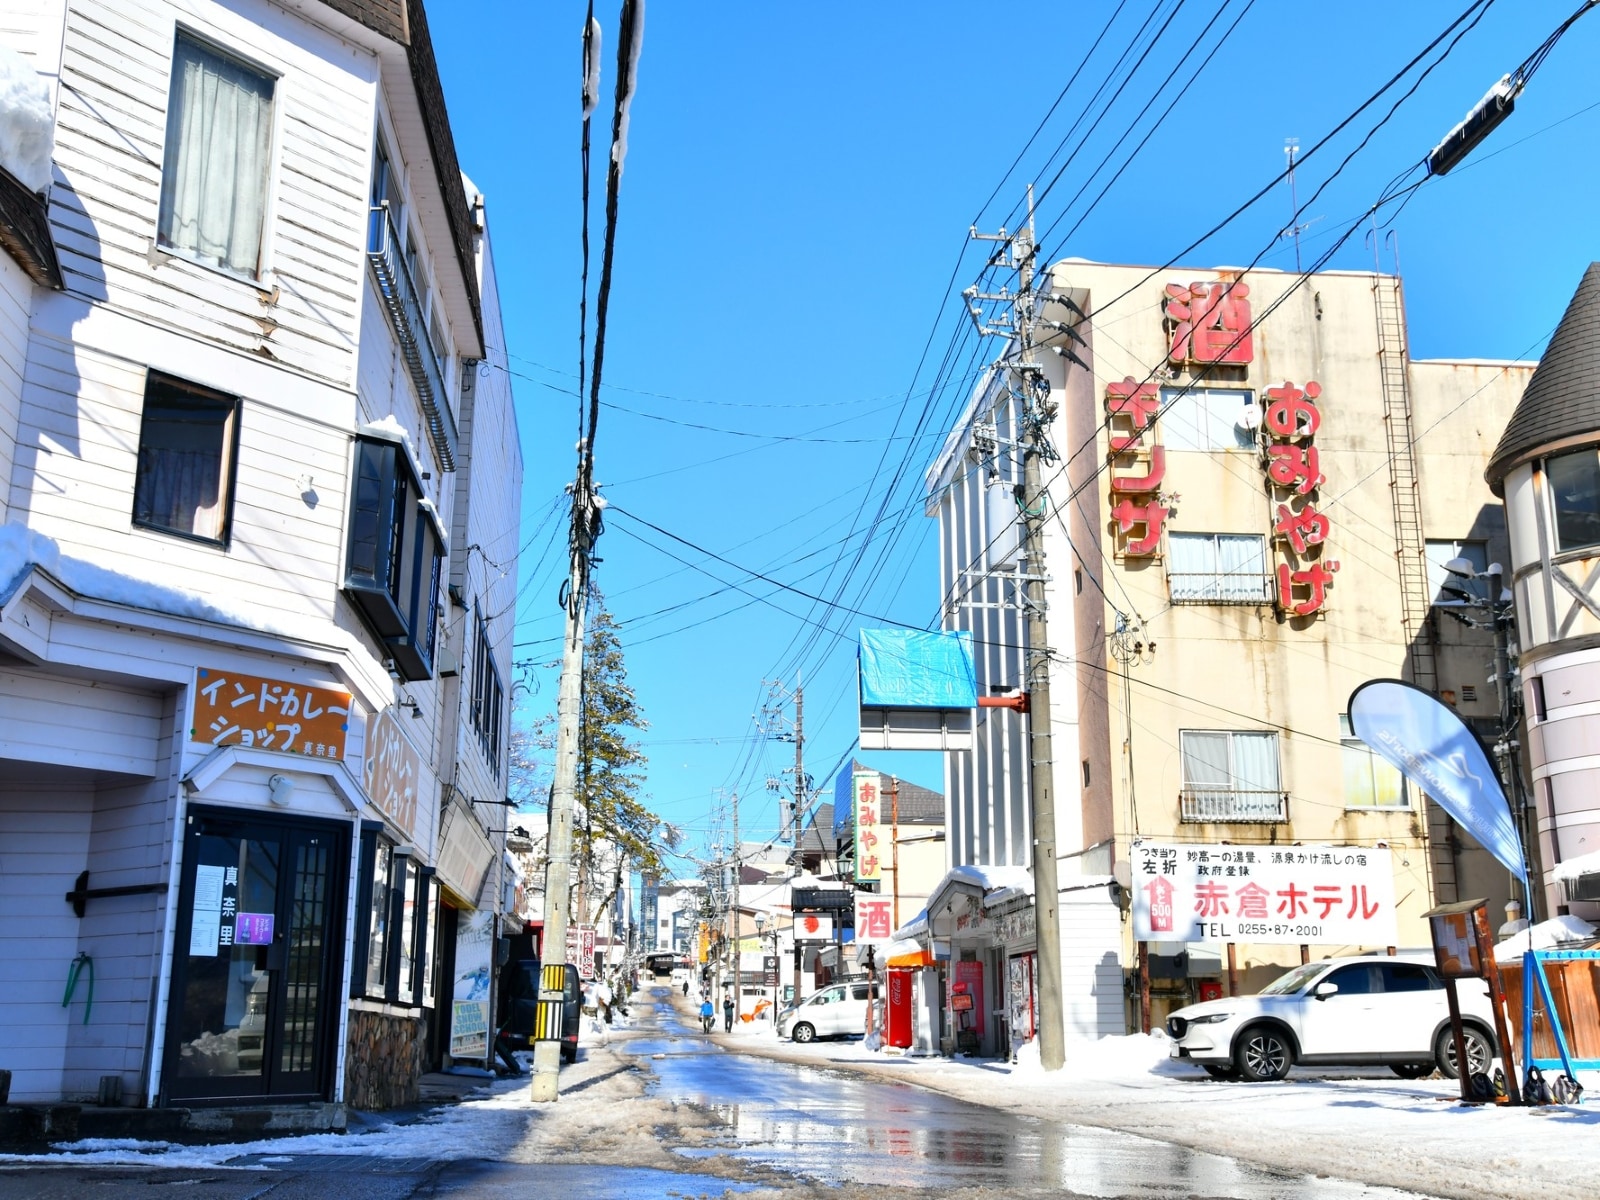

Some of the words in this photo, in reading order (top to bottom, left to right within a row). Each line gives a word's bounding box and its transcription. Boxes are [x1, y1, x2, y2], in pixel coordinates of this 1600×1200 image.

[1164, 281, 1254, 367] 酒
[1263, 381, 1340, 616] おみやげ
[201, 678, 349, 719] インドカレー
[210, 716, 302, 751] ショップ
[303, 741, 337, 759] 真奈里
[859, 782, 879, 876] おみやげ
[1140, 848, 1177, 859] つき当り
[1270, 852, 1367, 867] 源泉かけ流しの宿
[1142, 859, 1177, 875] 左折
[1197, 865, 1251, 877] 政府登録
[219, 866, 239, 946] 真奈里
[1194, 880, 1379, 920] 赤倉ホテル
[1151, 904, 1171, 917] 500
[858, 901, 891, 938] 酒
[1195, 923, 1231, 938] TEL
[454, 1002, 481, 1014] YODEL
[455, 1012, 482, 1025] SNOW
[454, 1021, 488, 1035] SCHOOL
